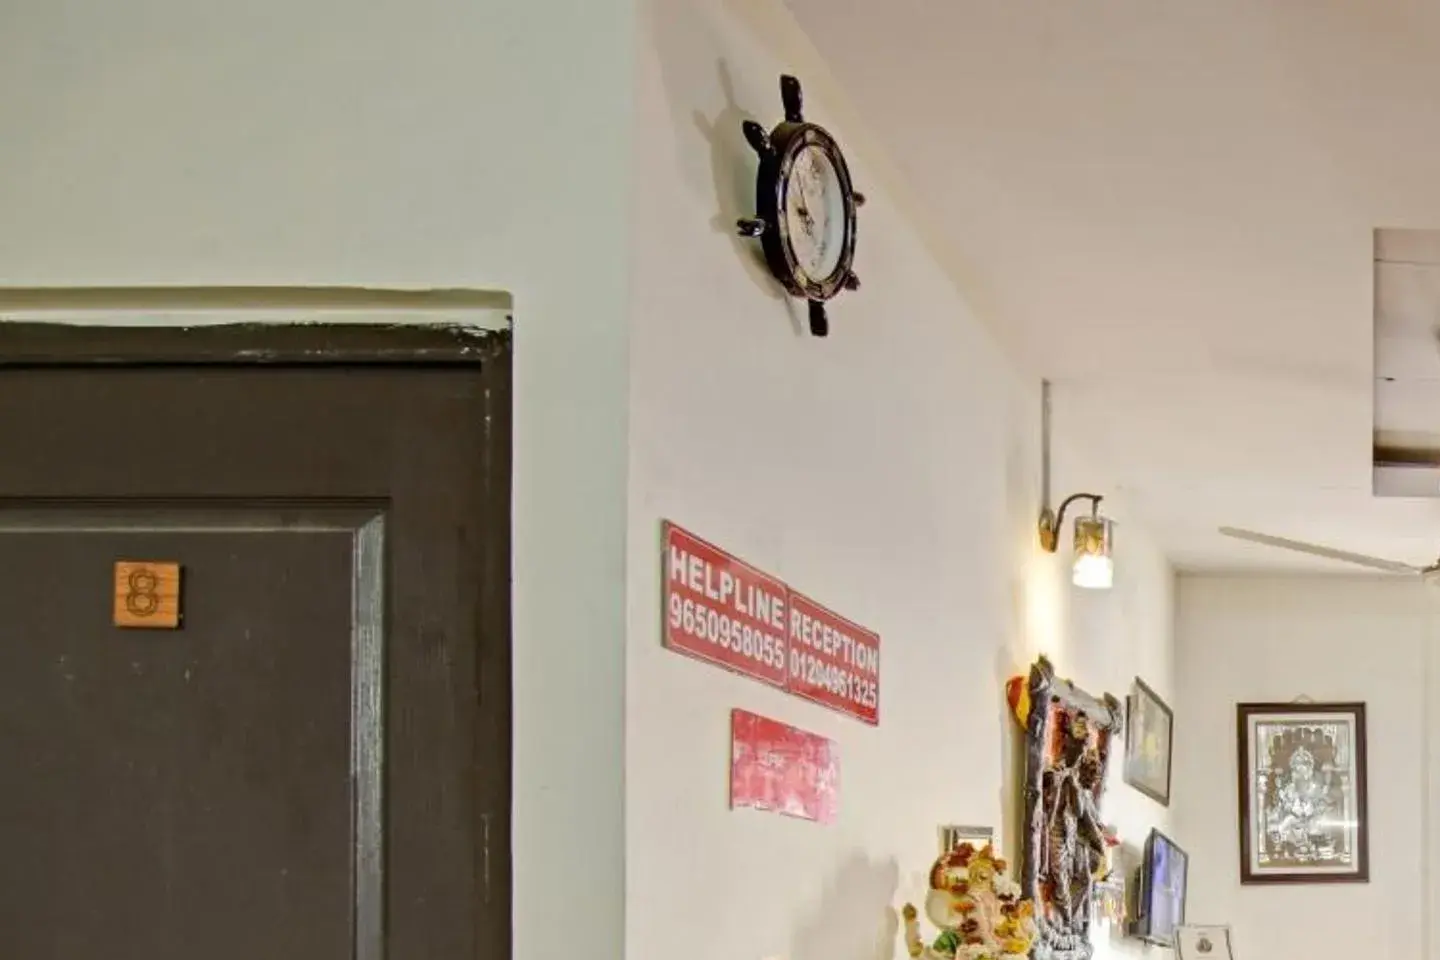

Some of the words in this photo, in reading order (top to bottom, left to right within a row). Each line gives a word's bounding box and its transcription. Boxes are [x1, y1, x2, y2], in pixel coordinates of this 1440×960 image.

[126, 568, 158, 617] 8
[671, 546, 785, 630] HELPLINE
[671, 592, 784, 669] 9650958055
[790, 608, 878, 676] RECEPTION
